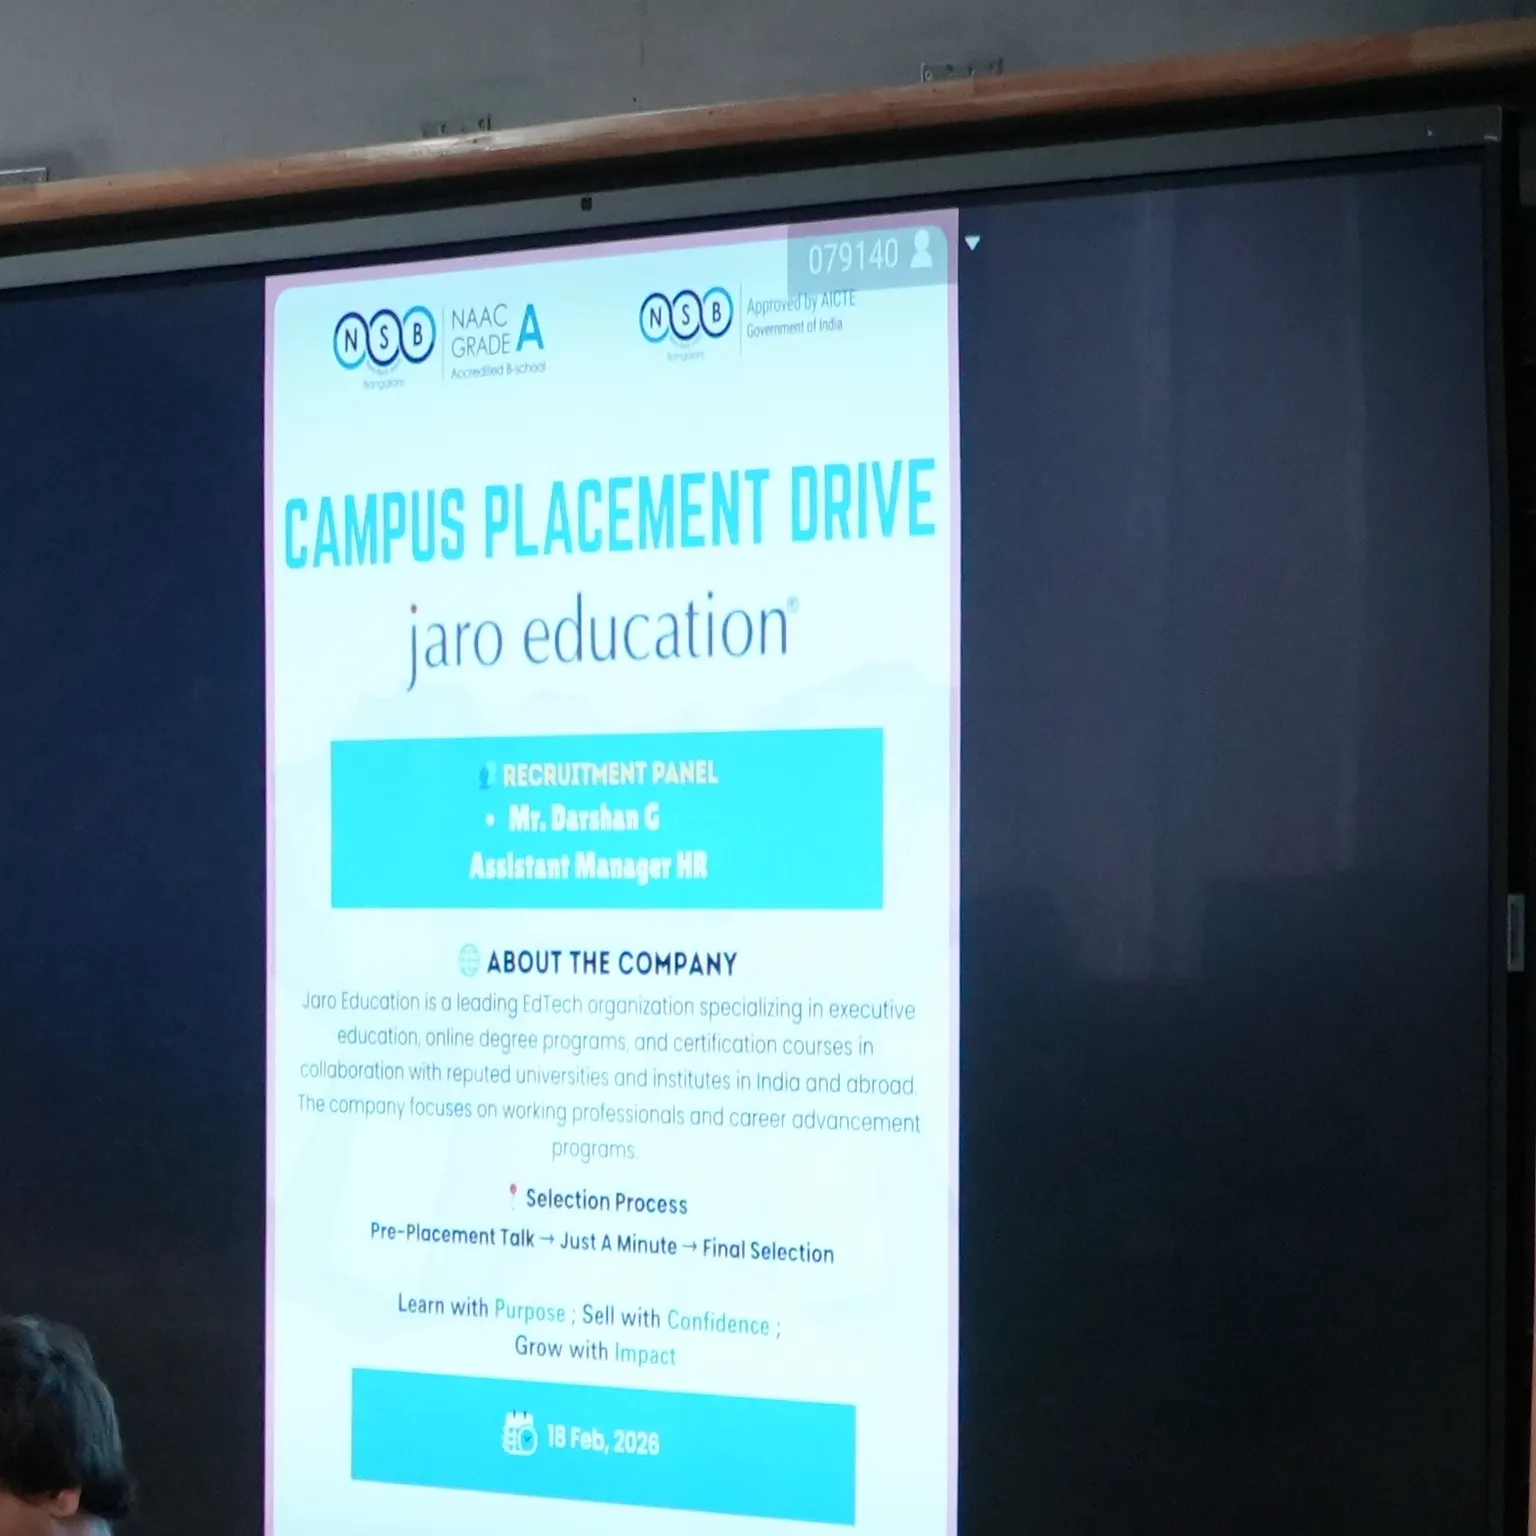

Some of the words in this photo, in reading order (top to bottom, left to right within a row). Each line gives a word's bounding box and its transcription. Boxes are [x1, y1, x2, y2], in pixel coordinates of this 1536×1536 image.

[808, 237, 899, 275] 079140
[747, 296, 801, 316] Approved
[805, 292, 819, 311] by
[822, 288, 857, 308] AICTE
[452, 303, 508, 331] NAAC
[516, 303, 545, 351] A
[747, 319, 804, 339] Government
[807, 318, 817, 333] of
[819, 317, 844, 332] India
[452, 332, 511, 358] GRADE
[284, 487, 465, 570] CAMPUS
[484, 468, 771, 560] PLACEMENT
[790, 457, 938, 543] DRIVE
[407, 603, 504, 693] jaro
[503, 762, 647, 788] RECRUITMENT
[652, 760, 718, 785] PANEL
[509, 804, 546, 832] Mr.
[551, 802, 639, 832] Darshan
[644, 801, 660, 830] G
[469, 851, 571, 880] Assistant
[575, 851, 672, 886] Manager
[676, 850, 708, 880] HR
[487, 950, 562, 973] ABOUT
[570, 951, 610, 974] THE
[618, 951, 737, 976] COMPANY
[302, 991, 336, 1010] Jaro
[342, 991, 419, 1012] Education
[425, 992, 436, 1011] is
[441, 996, 451, 1011] a
[457, 992, 517, 1018] leading
[524, 994, 581, 1013] EdTech
[588, 995, 694, 1020] organization
[700, 996, 802, 1024] specializing
[809, 998, 823, 1018] in
[829, 998, 915, 1020] executive
[337, 1026, 421, 1047] education,
[426, 1027, 474, 1047] online
[479, 1029, 538, 1054] degree
[543, 1032, 629, 1056] programs,
[634, 1033, 667, 1051] and
[673, 1032, 776, 1053] certification
[782, 1038, 852, 1056] courses
[859, 1036, 874, 1056] in
[300, 1060, 404, 1080] collaboration
[409, 1062, 441, 1081] with
[447, 1065, 510, 1087] reputed
[516, 1066, 609, 1086] universities
[614, 1069, 647, 1088] and
[653, 1068, 730, 1090] institutes
[736, 1070, 751, 1091] in
[757, 1072, 800, 1092] India
[806, 1073, 841, 1093] and
[847, 1074, 918, 1095] abroad.
[298, 1094, 325, 1113] The
[329, 1097, 405, 1120] company
[410, 1096, 472, 1118] focuses
[477, 1103, 497, 1118] on
[503, 1101, 566, 1127] working
[573, 1104, 684, 1127] professionals
[690, 1107, 723, 1127] and
[730, 1110, 786, 1128] career
[792, 1110, 921, 1133] advancement
[552, 1142, 640, 1164] programs.
[526, 1188, 610, 1211] Selection
[615, 1192, 688, 1215] Process
[370, 1221, 496, 1246] Pre-Placement
[500, 1228, 535, 1248] Talk
[560, 1232, 597, 1251] Just
[601, 1233, 612, 1252] A
[617, 1233, 677, 1255] Minute
[703, 1237, 746, 1259] Final
[750, 1241, 835, 1264] Selection
[398, 1292, 445, 1315] Learn
[451, 1296, 488, 1318] with
[495, 1298, 566, 1324] Purpose
[582, 1304, 615, 1326] Sell
[621, 1306, 661, 1329] with
[667, 1309, 769, 1336] Confidence
[515, 1335, 562, 1358] Grow
[569, 1339, 608, 1361] with
[615, 1341, 676, 1368] Impact
[547, 1423, 566, 1448] 18
[570, 1426, 609, 1455] Feb,
[613, 1429, 660, 1456] 2026
